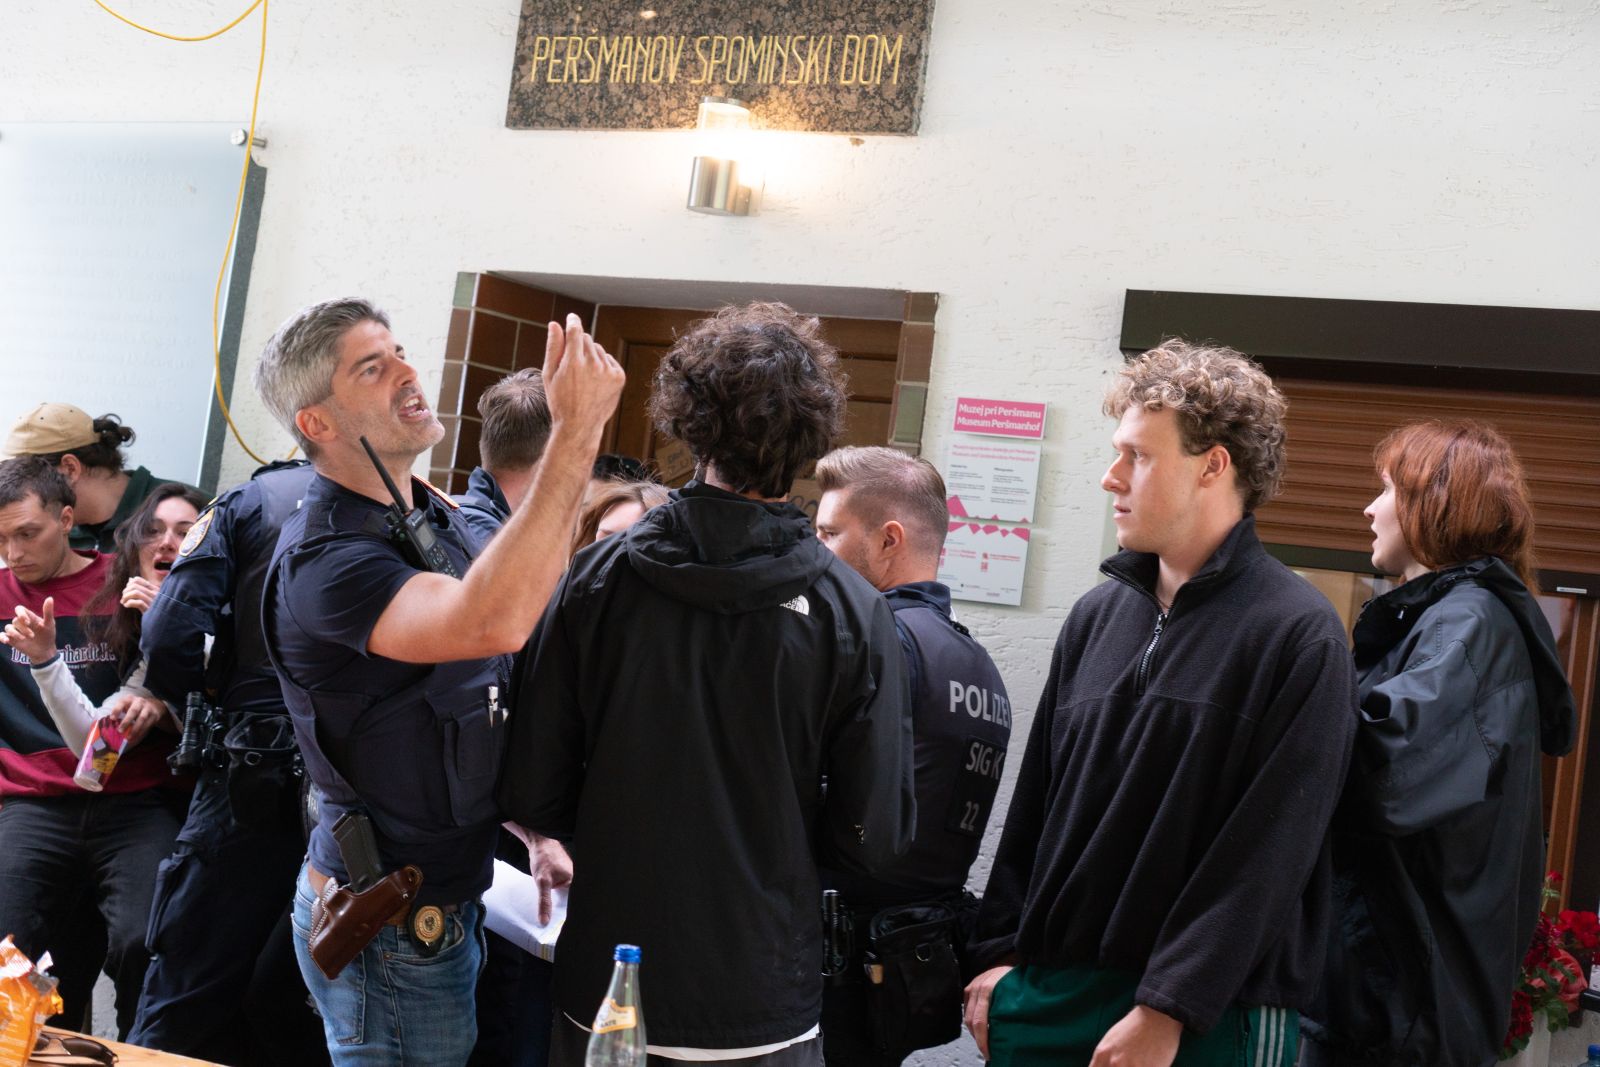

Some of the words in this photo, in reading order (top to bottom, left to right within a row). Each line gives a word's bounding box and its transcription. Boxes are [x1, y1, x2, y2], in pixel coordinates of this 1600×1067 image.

[530, 28, 686, 84] PERŠMANOV
[690, 35, 833, 85] SPOMINSKI
[840, 34, 903, 85] DOM
[957, 417, 991, 427] Museum
[958, 404, 984, 416] Muzej
[984, 406, 997, 417] pri
[966, 742, 991, 775] SIG
[992, 752, 1004, 780] K
[960, 802, 979, 831] 22
